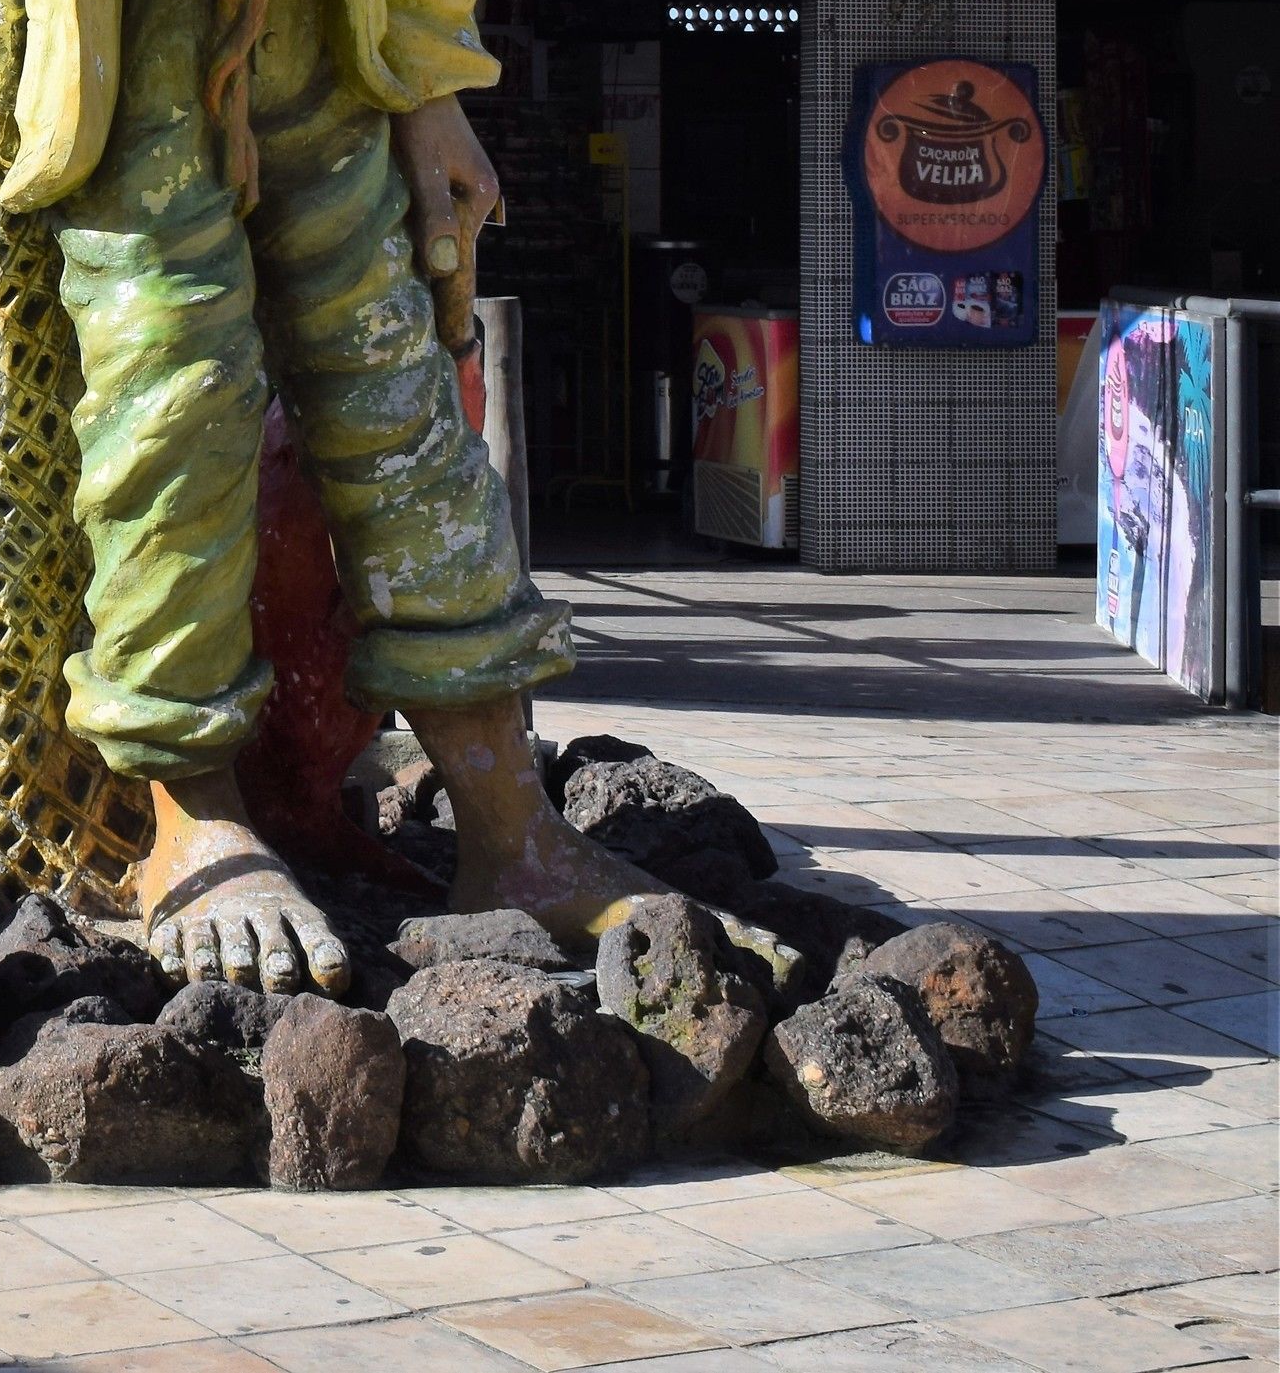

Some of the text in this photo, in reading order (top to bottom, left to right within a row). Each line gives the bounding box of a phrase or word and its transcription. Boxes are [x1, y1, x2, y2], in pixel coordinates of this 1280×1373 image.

[918, 146, 980, 162] CAÇAROLA
[916, 161, 985, 186] VELHA
[896, 212, 1010, 226] SUPERMERCADO
[897, 276, 930, 292] SÃO
[890, 292, 938, 306] BRAZ
